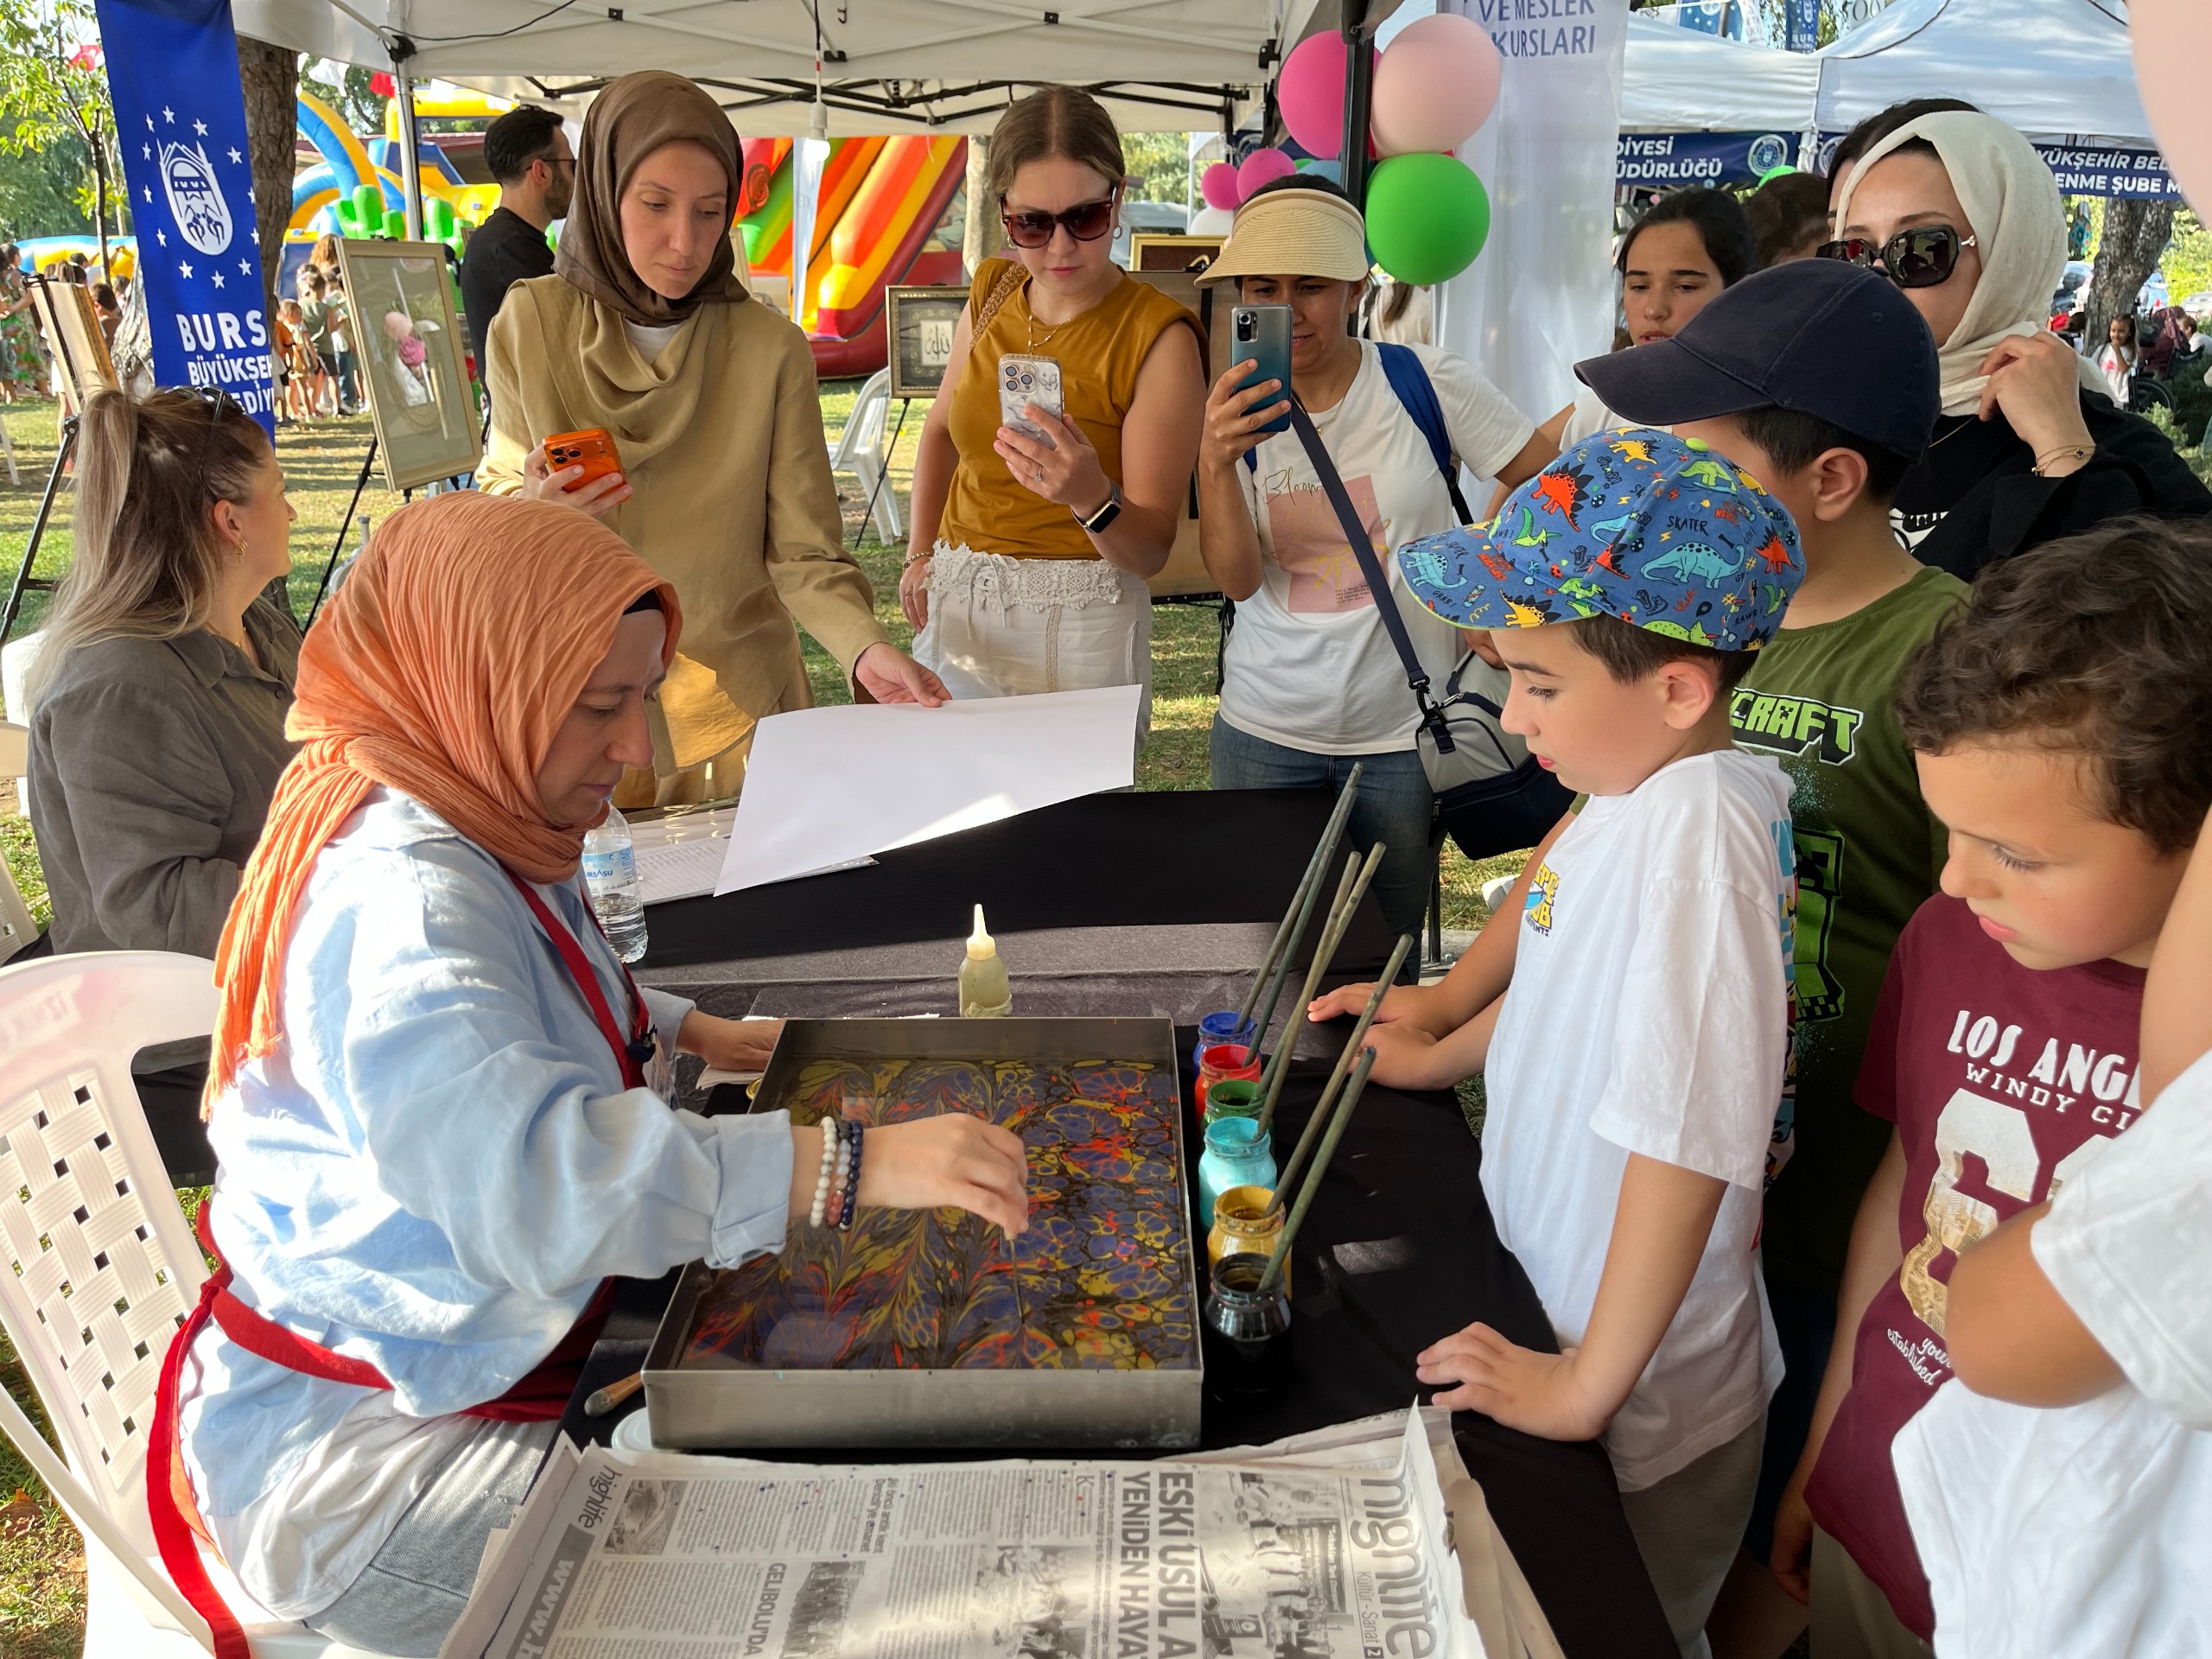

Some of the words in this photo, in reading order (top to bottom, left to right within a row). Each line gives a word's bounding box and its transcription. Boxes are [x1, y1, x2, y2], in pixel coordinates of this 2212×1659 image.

[1491, 25, 1595, 57] KURSLARI
[2111, 176, 2161, 195] ŞUBE
[175, 309, 270, 352] BURS
[1667, 516, 1709, 537] SKATER
[1731, 689, 1862, 760] CRAFT
[1948, 1010, 2023, 1066] LOS
[1966, 1062, 2075, 1112] WINDY
[578, 1465, 623, 1529] highlife
[1121, 1471, 1150, 1577] YENİDEN
[1159, 1472, 1194, 1536] ESKİ
[1158, 1545, 1196, 1627] USUL
[1117, 1585, 1149, 1659] HAYA
[1362, 1611, 1381, 1644] Sanat
